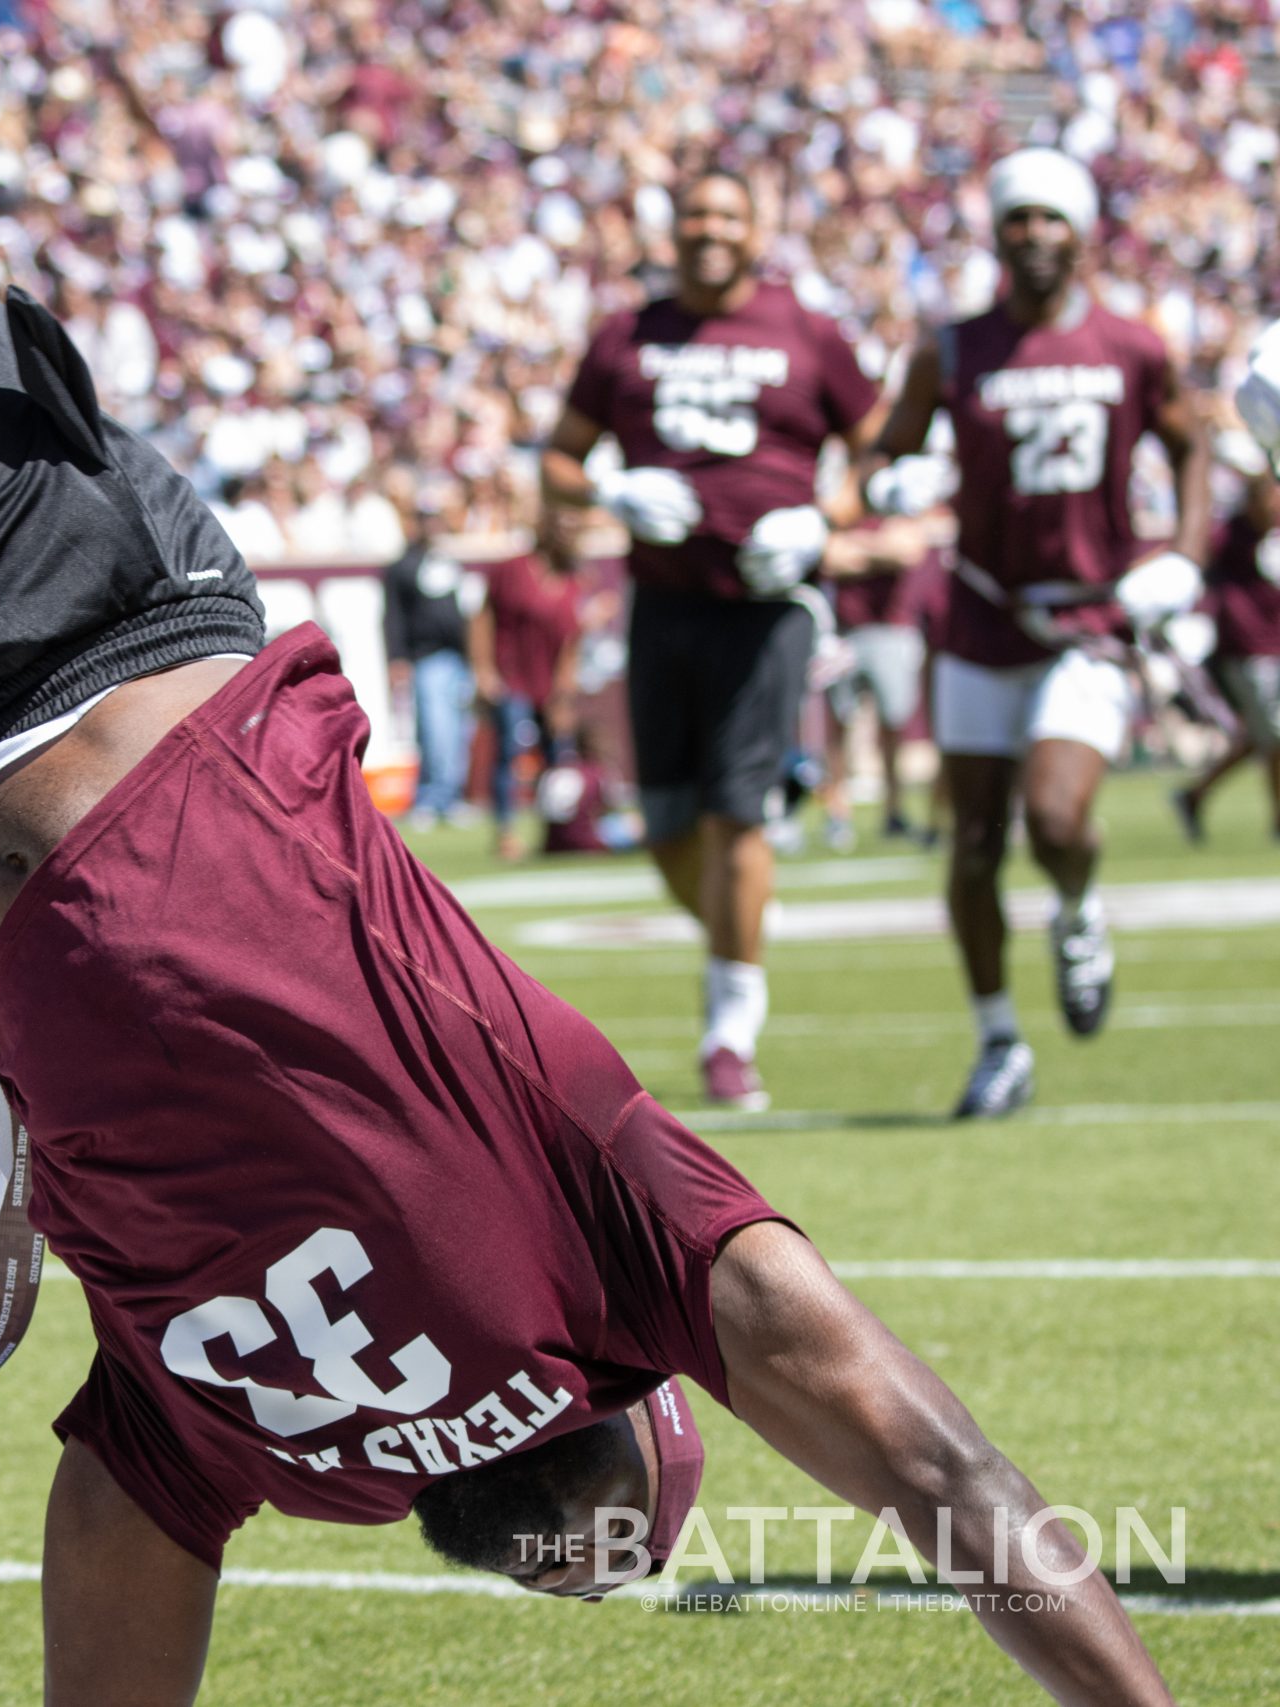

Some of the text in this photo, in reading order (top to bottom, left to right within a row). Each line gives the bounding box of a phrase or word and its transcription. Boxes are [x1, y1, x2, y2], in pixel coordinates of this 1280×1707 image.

[1003, 400, 1108, 496] 23
[5, 1257, 18, 1291] AGGIE
[29, 1233, 44, 1284] LEGENDS
[159, 1226, 452, 1438] 33
[362, 1369, 574, 1475] TEXAS
